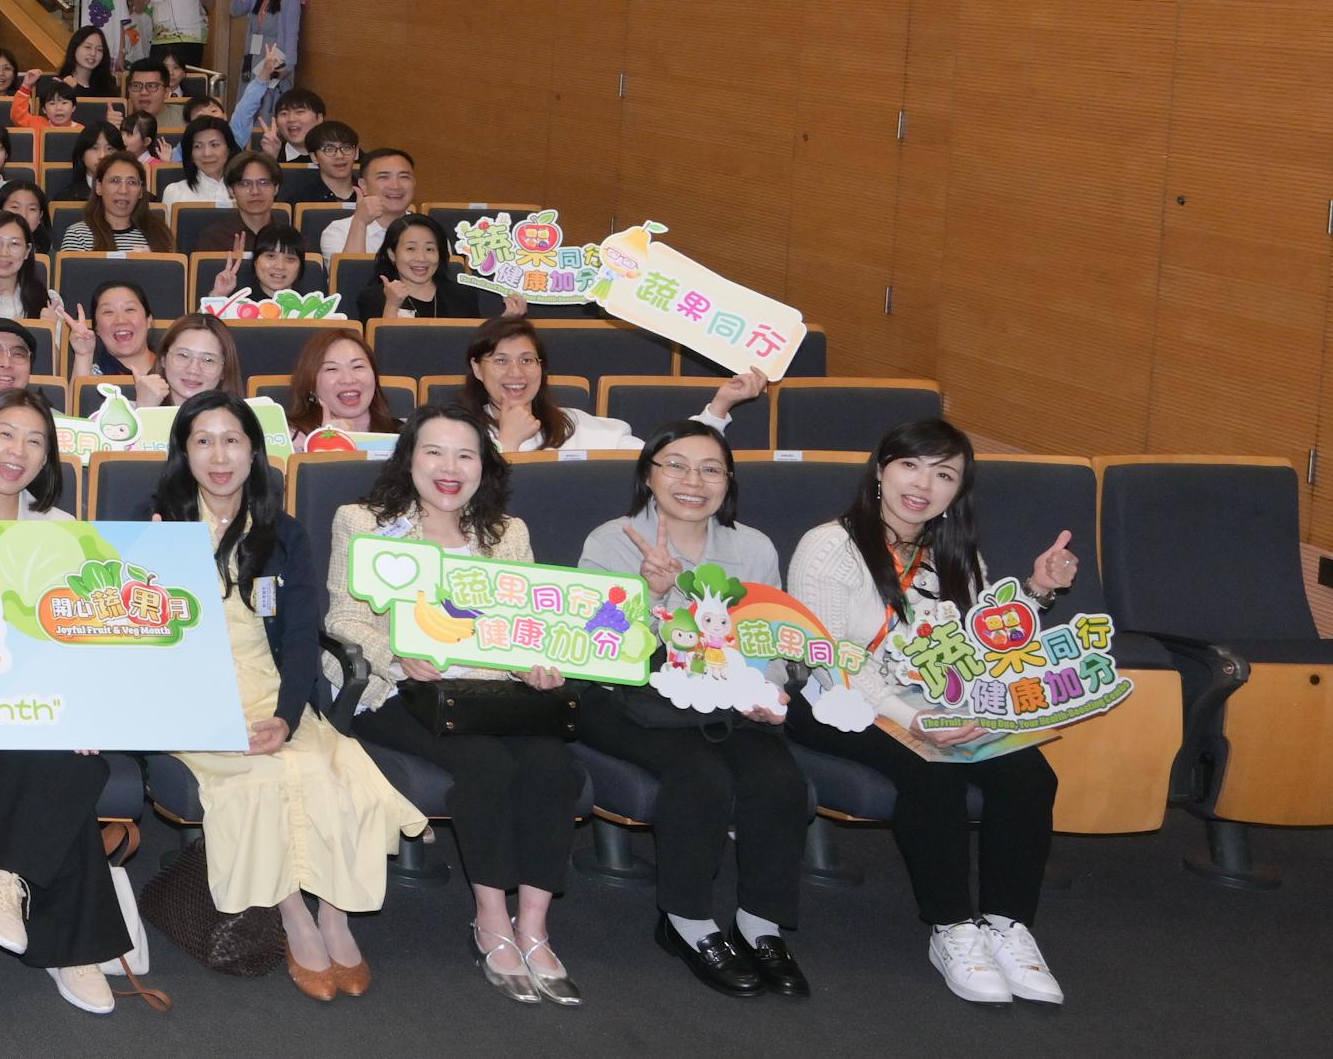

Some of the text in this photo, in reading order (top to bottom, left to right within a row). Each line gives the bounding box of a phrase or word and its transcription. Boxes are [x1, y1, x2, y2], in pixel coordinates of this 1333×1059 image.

[636, 272, 786, 357] 蔬果同行
[51, 587, 190, 622] 開心蔬果月
[449, 570, 601, 617] 蔬果同行
[55, 625, 172, 637] Joyful Fruit & Veg Month
[476, 618, 621, 663] 健康加分
[737, 620, 865, 670] 蔬果同行
[971, 652, 1116, 715] 健康加分
